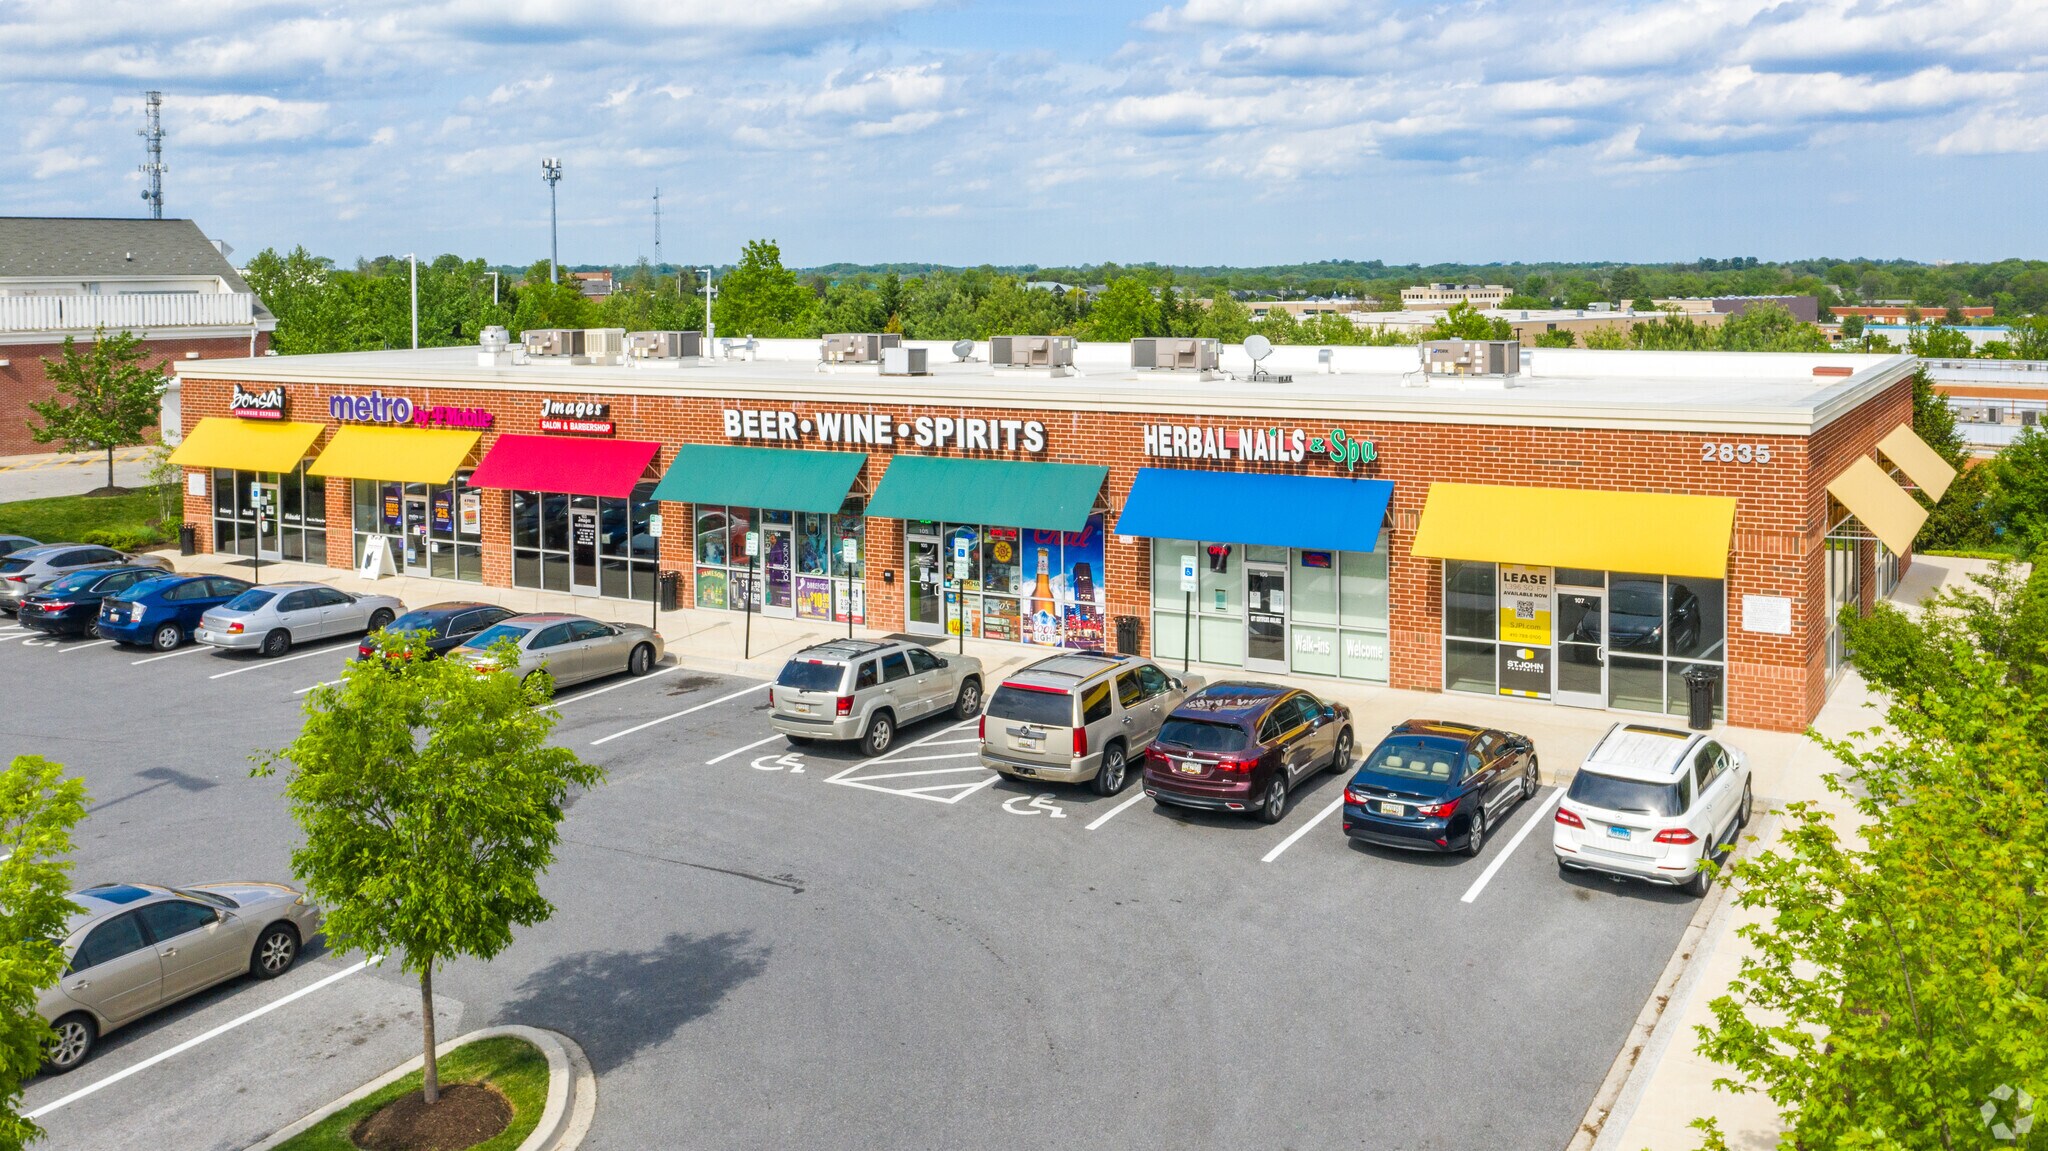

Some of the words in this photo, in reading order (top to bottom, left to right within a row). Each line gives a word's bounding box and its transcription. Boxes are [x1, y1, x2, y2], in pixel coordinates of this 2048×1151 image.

[330, 391, 413, 423] metro
[413, 405, 430, 428] by
[541, 420, 562, 430] SALON
[563, 421, 568, 430] &
[569, 422, 611, 432] BARBERSHOP
[723, 409, 798, 440] BEER
[815, 413, 893, 444] WINE
[914, 416, 1045, 452] SPIRITS
[1144, 425, 1230, 459] HERBAL
[1310, 438, 1325, 453] &
[1330, 429, 1377, 471] Spa
[1702, 442, 1771, 464] 2835
[1503, 572, 1547, 585] LEASE
[1294, 634, 1331, 656] Walk-ins
[1346, 639, 1384, 660] Welcome
